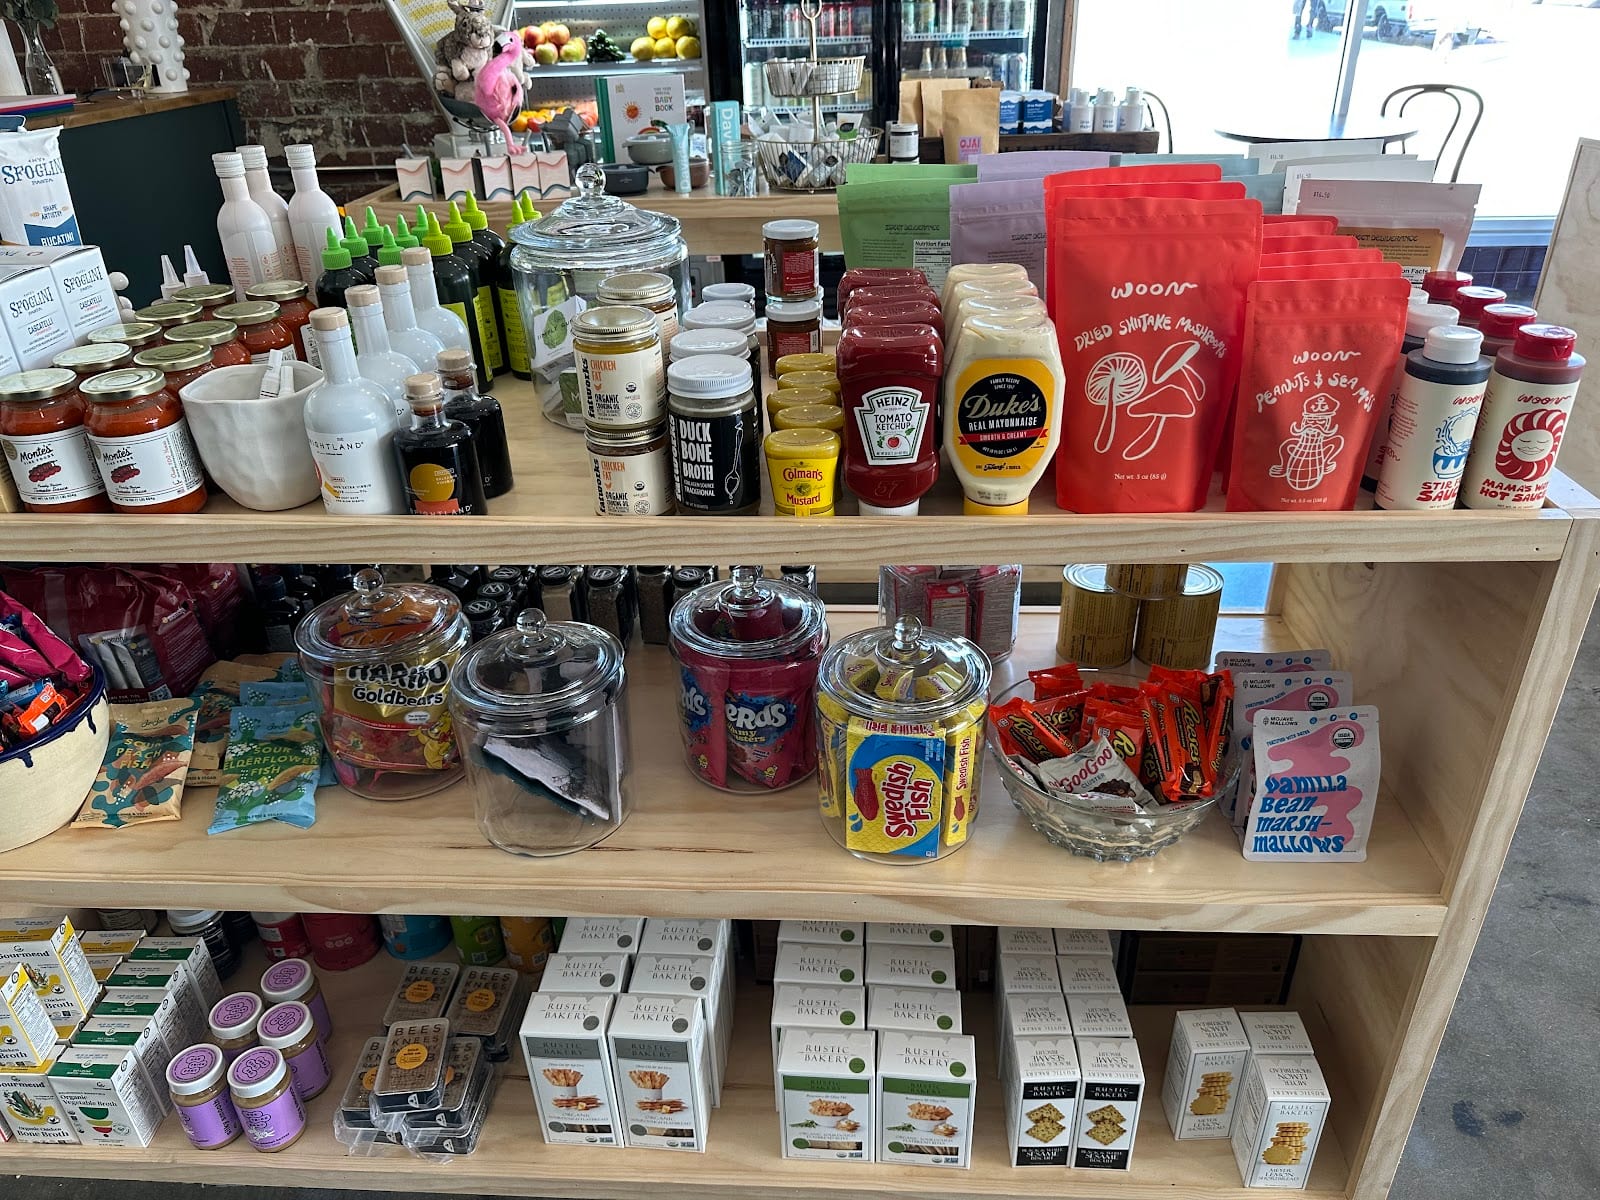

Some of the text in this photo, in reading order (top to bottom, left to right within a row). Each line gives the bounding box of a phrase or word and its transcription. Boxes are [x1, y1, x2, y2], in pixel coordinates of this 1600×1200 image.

[655, 104, 674, 112] BOOK
[960, 138, 980, 149] OJAI
[2, 158, 65, 185] SFOGLIN
[40, 232, 75, 246] BUCATINI
[63, 266, 103, 294] SFOGLINI
[9, 286, 54, 318] SFOGLINI
[79, 295, 102, 310] CASCATELLI
[27, 317, 54, 335] CASCATELLI
[1074, 325, 1113, 352] DRIED
[591, 360, 616, 370] CHICKEN
[592, 371, 601, 380] FAT
[1256, 371, 1358, 413] PEANUTS SEA
[595, 394, 619, 404] ORGANIC
[876, 396, 909, 408] HEINZ
[964, 394, 1041, 419] Duke's
[874, 413, 913, 423] TOMATO
[876, 423, 911, 431] KETCHUP
[968, 417, 1038, 432] REAL MAYONNAISE
[679, 420, 712, 442] DUCK
[20, 445, 54, 462] Monte's
[102, 447, 133, 462] Monte's
[681, 441, 713, 463] BONE
[601, 461, 625, 471] CHICKEN
[683, 462, 714, 480] BROTH
[602, 471, 611, 480] FAT
[783, 468, 823, 482] Colman's
[1421, 480, 1453, 490] STIR
[1482, 479, 1532, 492] MAMA'S
[605, 492, 628, 501] ORGANIC
[684, 486, 715, 497] TRADITIONAL
[1480, 486, 1547, 502] HOT SAUCE
[786, 493, 820, 505] Mustard
[352, 687, 444, 707] Goldbears
[124, 737, 162, 748] SOUR
[116, 748, 162, 758] PEACH
[253, 746, 292, 755] SOUR
[119, 760, 151, 769] FISH
[223, 756, 319, 771] ELDERFLOWER
[957, 737, 971, 791] Swedish Fish
[251, 766, 281, 776] FISH
[1081, 773, 1106, 789] CLUSTER
[881, 761, 914, 838] Swedish
[905, 780, 933, 821] Fish
[583, 925, 623, 933] RUSTIC
[663, 926, 703, 935] RUSTIC
[801, 925, 841, 935] BAKERY
[889, 927, 930, 936] BAKERY
[580, 932, 621, 940] BAKERY
[661, 934, 701, 942] BAKERY
[564, 962, 605, 970] RUSTIC
[800, 957, 841, 966] RUSTIC
[890, 958, 931, 967] RUSTIC
[409, 966, 451, 976] BEES
[654, 963, 694, 972] RUSTIC
[799, 965, 840, 974] BAKERY
[890, 966, 931, 975] BAKERY
[468, 971, 511, 982] BEES
[562, 969, 604, 978] BAKERY
[652, 972, 694, 981] BAKERY
[465, 982, 507, 990] KNEES
[45, 1001, 74, 1009] Broth
[547, 1002, 590, 1011] RUSTIC
[798, 998, 841, 1008] RUSTIC
[894, 1001, 937, 1011] RUSTIC
[635, 1004, 678, 1013] RUSTIC
[797, 1007, 840, 1017] BAKERY
[544, 1011, 588, 1020] BAKERY
[633, 1013, 677, 1022] BAKERY
[893, 1011, 936, 1021] BAKERY
[395, 1024, 441, 1036] BEES
[392, 1036, 439, 1046] KNEES
[805, 1045, 849, 1055] RUSTIC
[905, 1047, 949, 1058] RUSTIC
[804, 1054, 849, 1064] BAKERY
[904, 1057, 949, 1067] BAKERY
